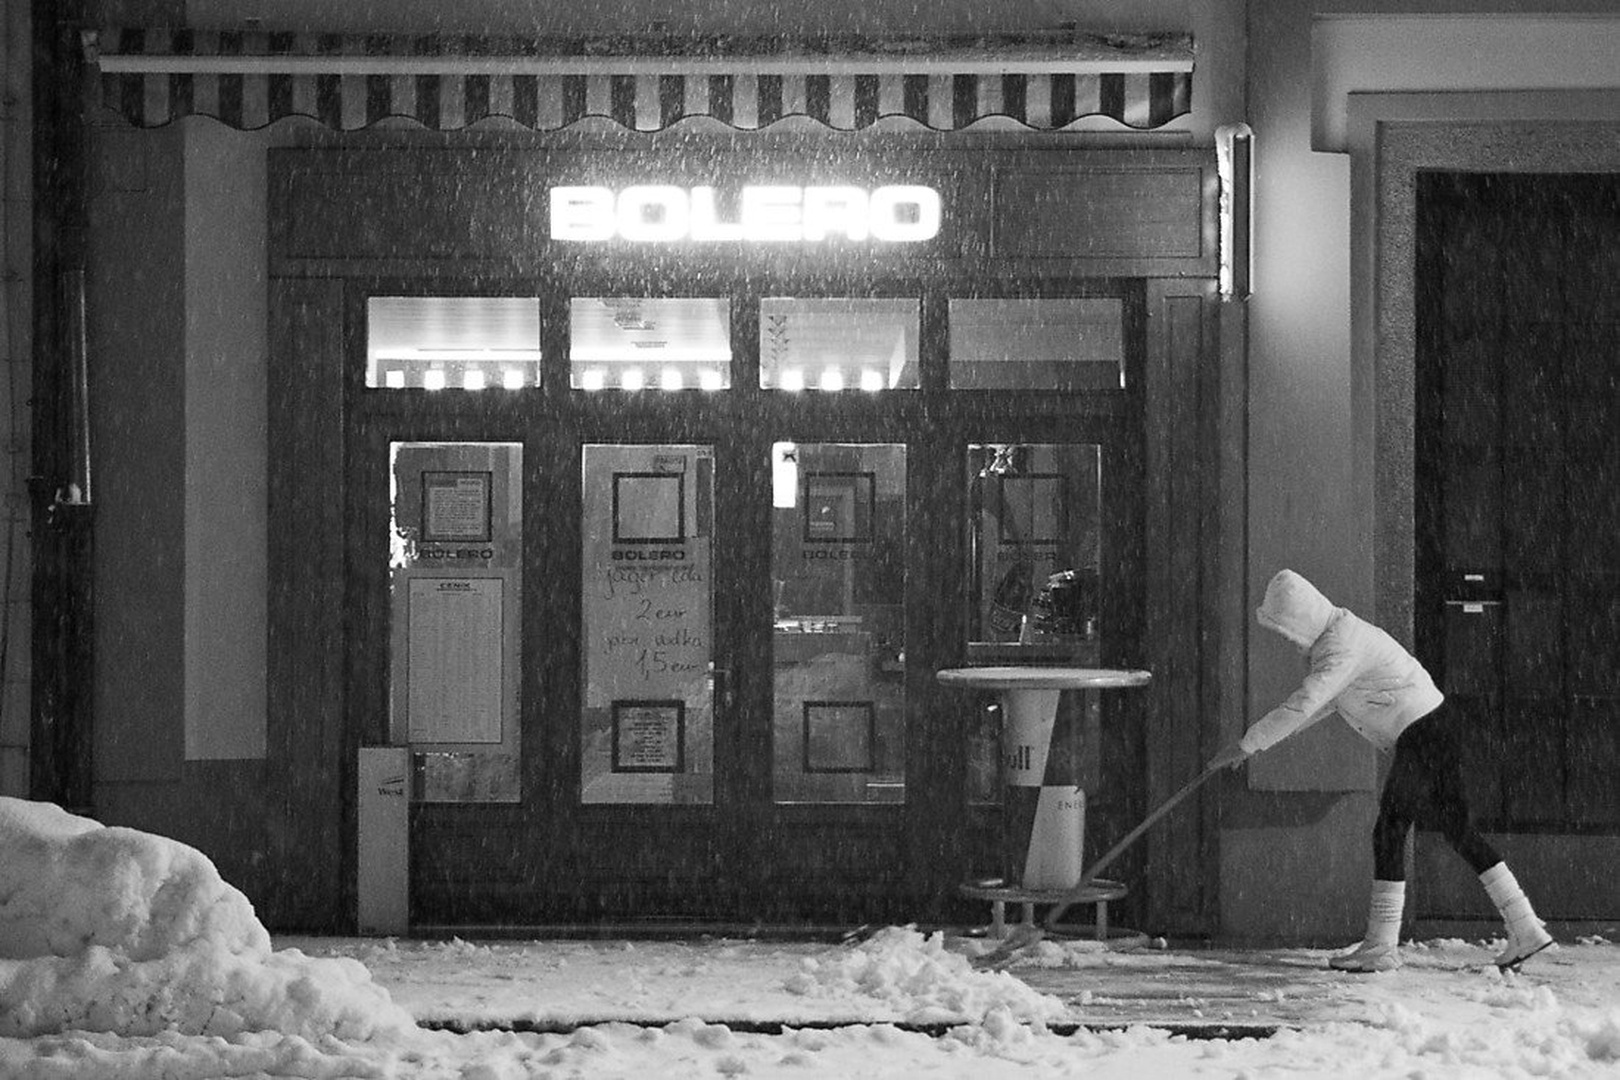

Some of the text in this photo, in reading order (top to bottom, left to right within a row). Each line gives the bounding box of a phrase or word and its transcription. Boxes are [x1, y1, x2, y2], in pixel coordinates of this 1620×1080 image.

[550, 186, 941, 241] BOLERO
[419, 549, 493, 560] BOLERO
[612, 550, 685, 561] BOLERO
[636, 599, 687, 620] 2 eur
[635, 649, 667, 680] 1,5
